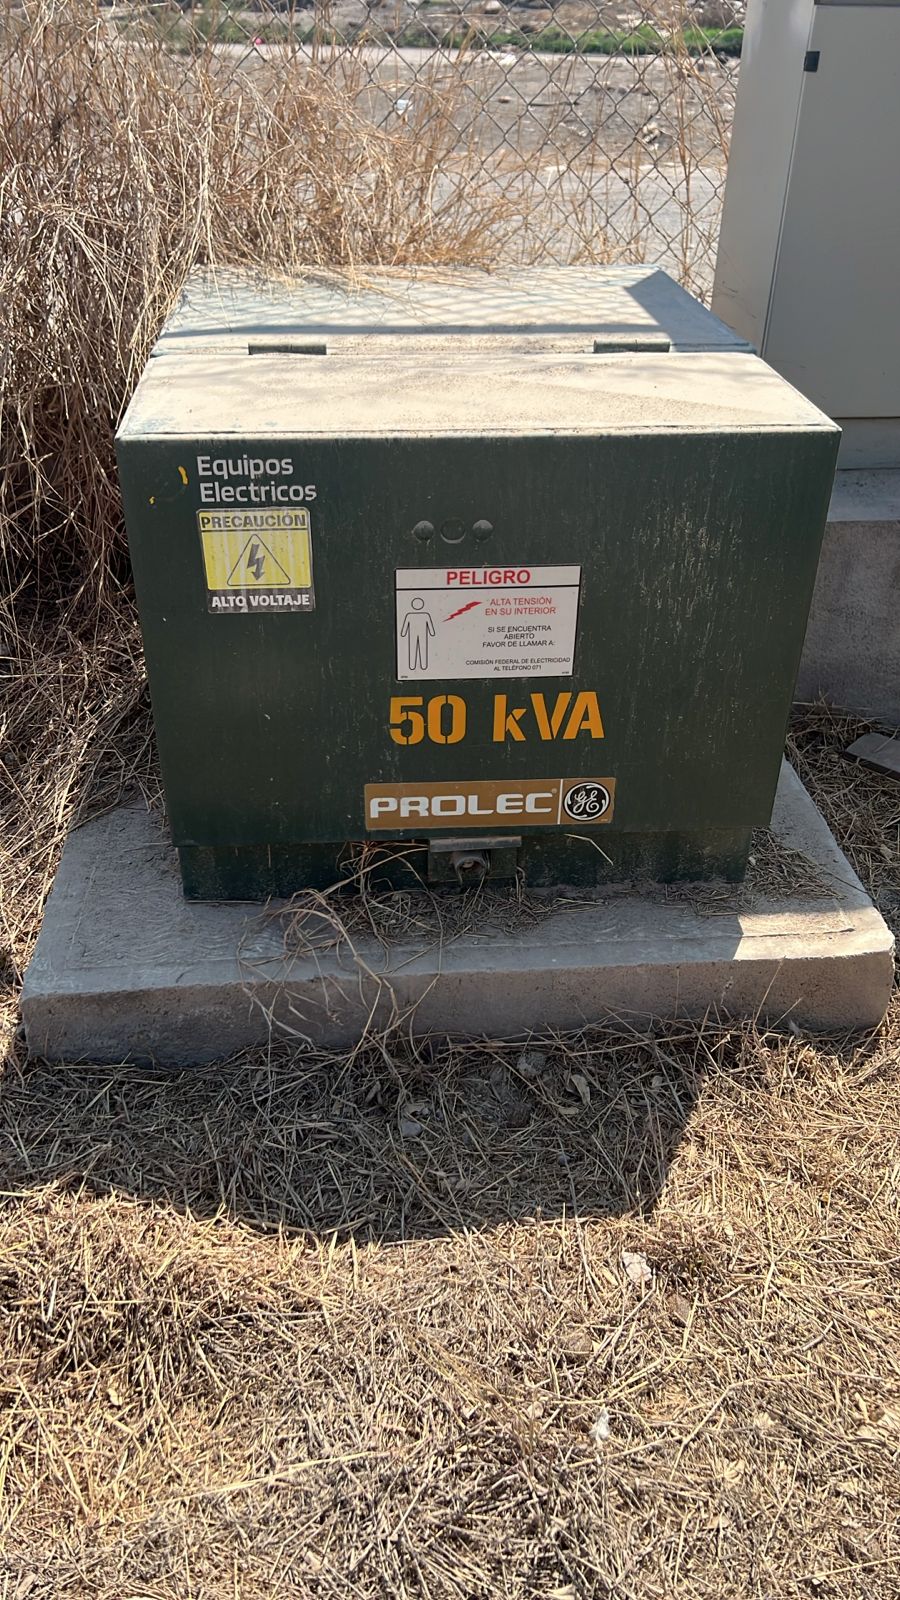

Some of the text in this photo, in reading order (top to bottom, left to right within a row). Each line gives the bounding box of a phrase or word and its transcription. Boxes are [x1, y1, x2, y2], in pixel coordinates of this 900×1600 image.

[196, 454, 294, 480] Equipos
[200, 481, 317, 502] Electricos
[201, 512, 306, 529] PRECAUCIÓN
[446, 570, 531, 586] PELIGRO
[212, 594, 310, 608] ALTO VOLTAJE
[490, 596, 552, 606] ALTA TENSIÓN
[485, 607, 556, 616] EN SU INTERIOR
[389, 691, 606, 746] 50 kVA
[370, 792, 554, 819] PROLEC
